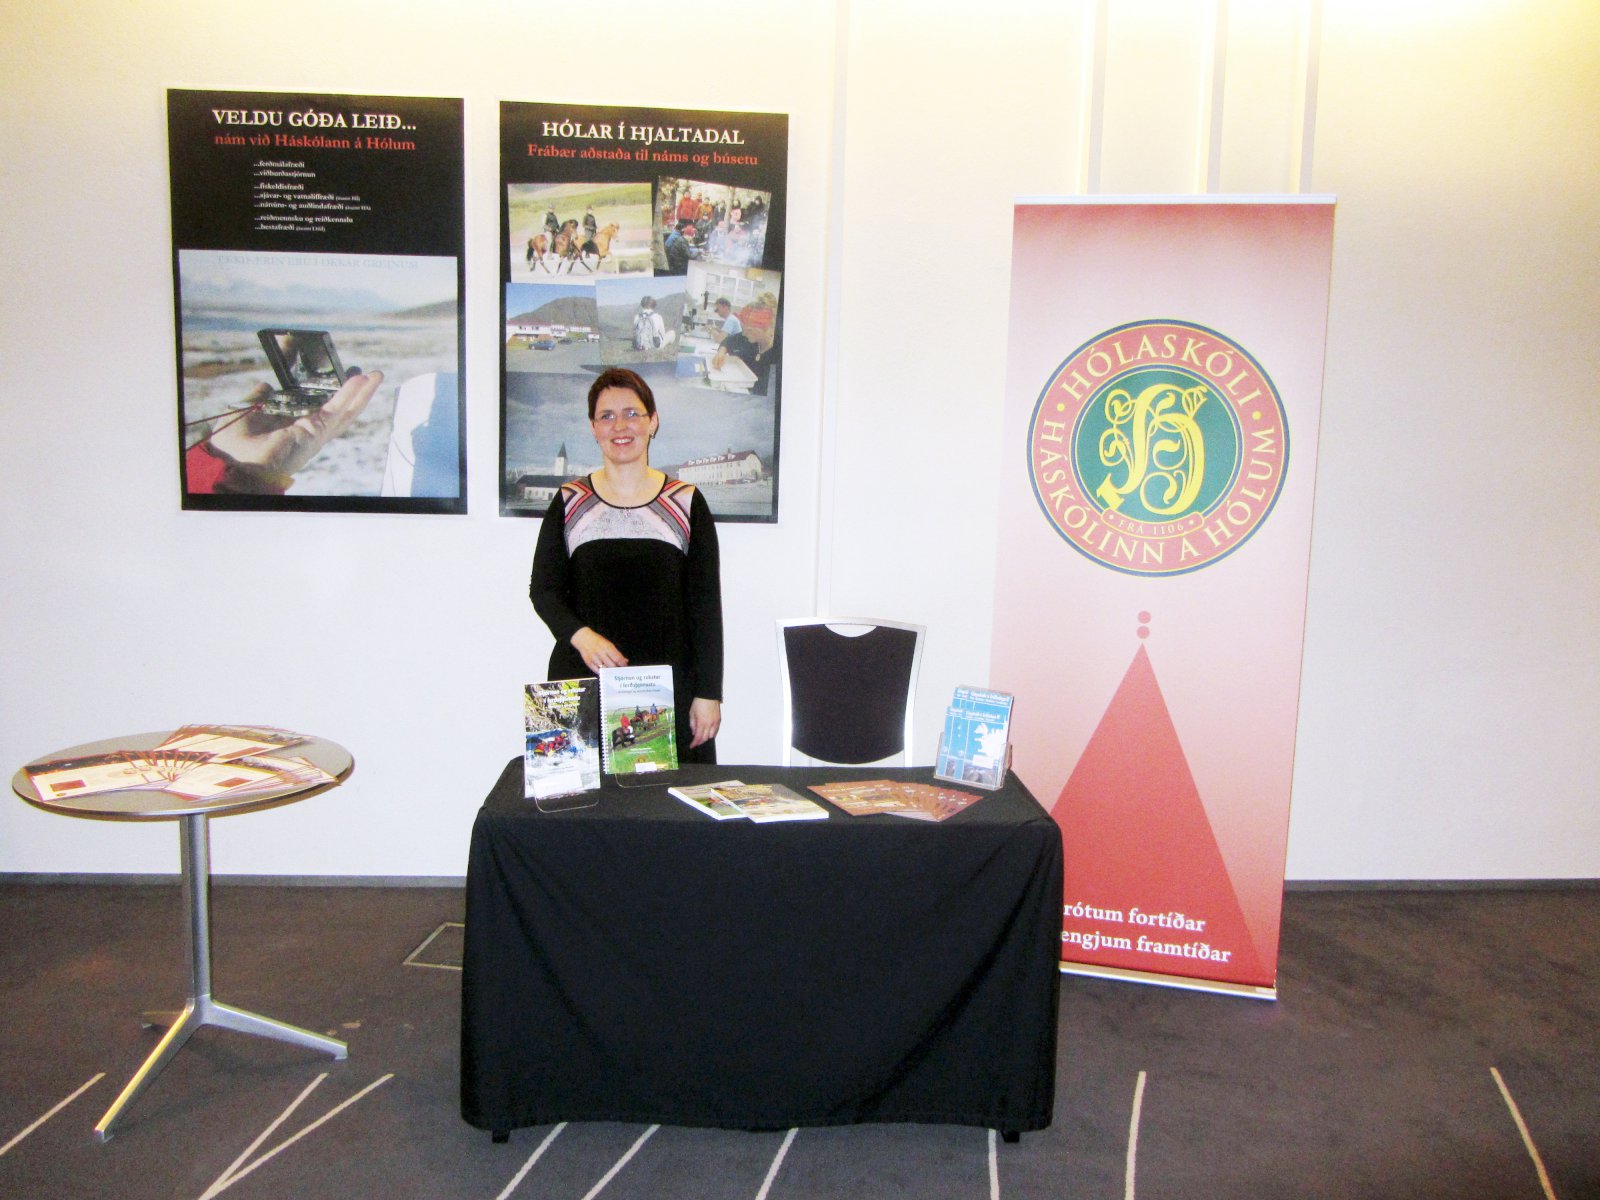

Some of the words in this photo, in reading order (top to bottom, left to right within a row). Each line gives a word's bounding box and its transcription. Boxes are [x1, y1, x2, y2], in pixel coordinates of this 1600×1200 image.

[212, 110, 283, 127] VELDU
[289, 109, 348, 129] GÓÐA
[352, 113, 417, 130] LEIÐ...
[214, 133, 246, 146] nám
[249, 133, 271, 146] við
[275, 134, 350, 149] Háskólann
[355, 136, 362, 149] á
[366, 137, 416, 151] Hólum
[543, 120, 613, 140] HÓLAR
[619, 123, 625, 140] Í
[631, 127, 745, 145] HJALTADAL
[528, 144, 577, 159] Frábær
[580, 149, 631, 161] aðstaða
[635, 149, 649, 161] til
[653, 151, 689, 164] náms
[692, 155, 710, 167] og
[713, 152, 758, 166] búsetu
[1060, 334, 1262, 407] HÓLASKÓLI
[1040, 418, 1164, 565] HÁSKÓLINN
[1203, 427, 1276, 547] HÓLUM
[1128, 908, 1206, 932] fortíðar
[1137, 936, 1231, 963] framtíðar
